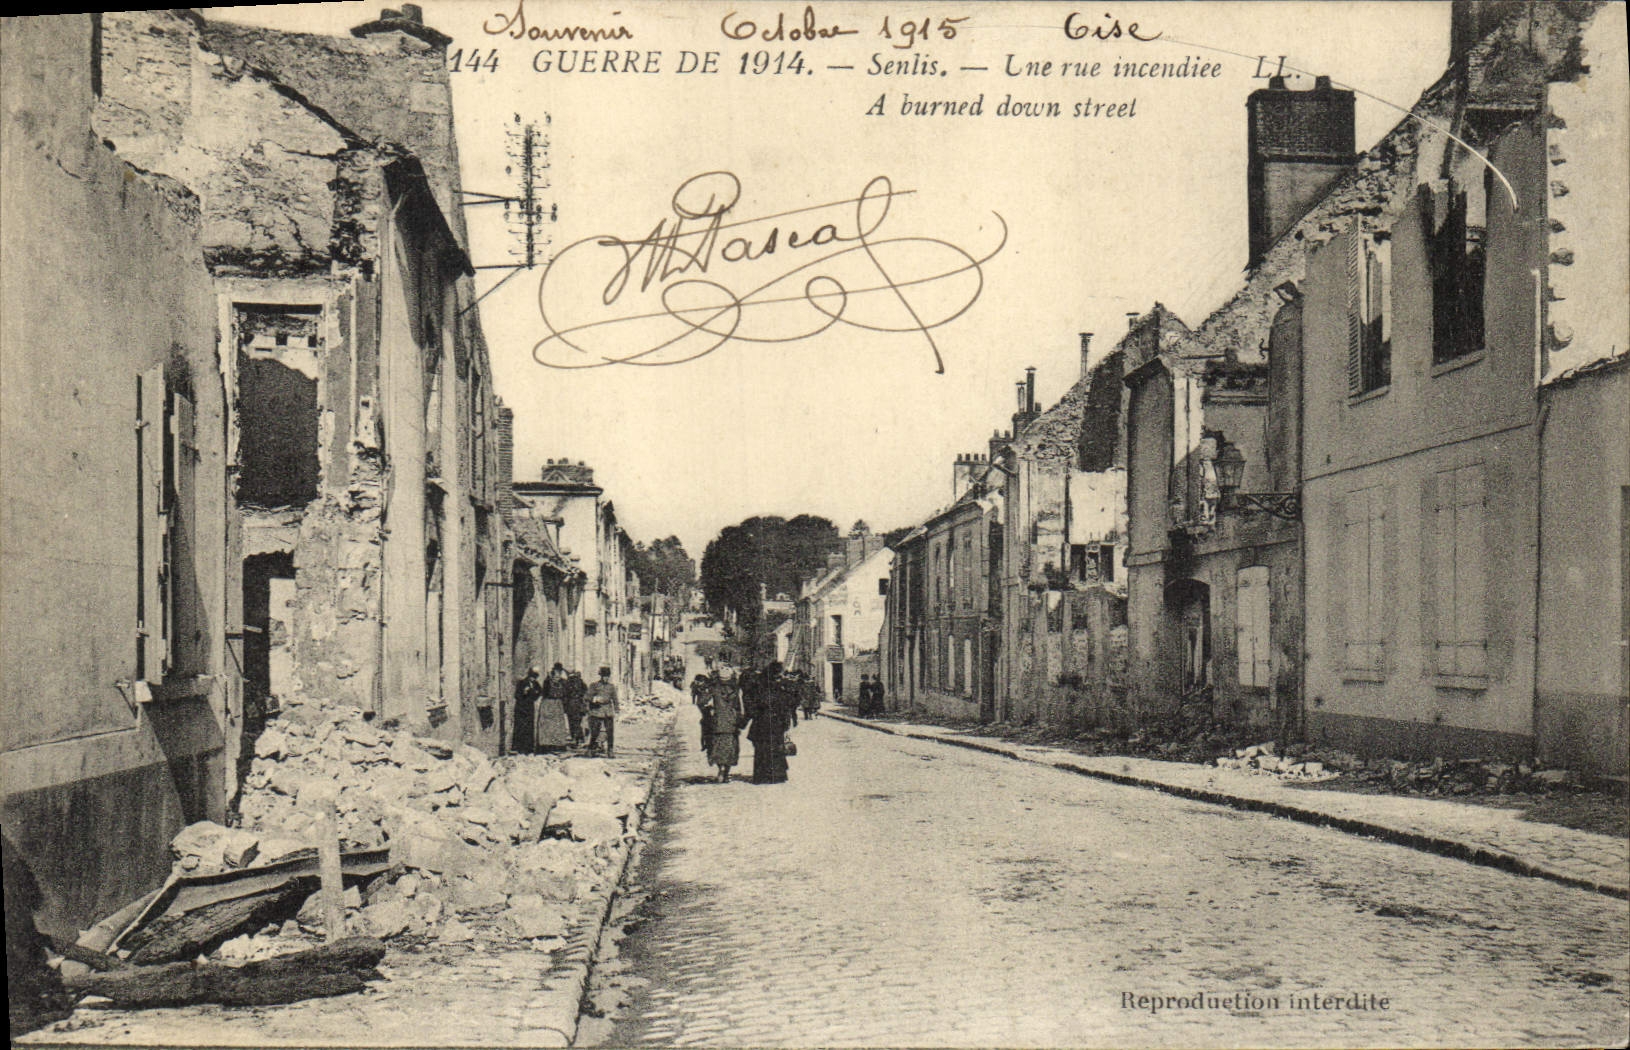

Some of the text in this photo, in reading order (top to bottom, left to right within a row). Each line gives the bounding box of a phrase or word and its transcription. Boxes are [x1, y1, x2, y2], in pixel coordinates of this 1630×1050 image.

[483, 0, 634, 41] Souvenir
[879, 16, 970, 49] 1915
[1064, 12, 1163, 41] Oise
